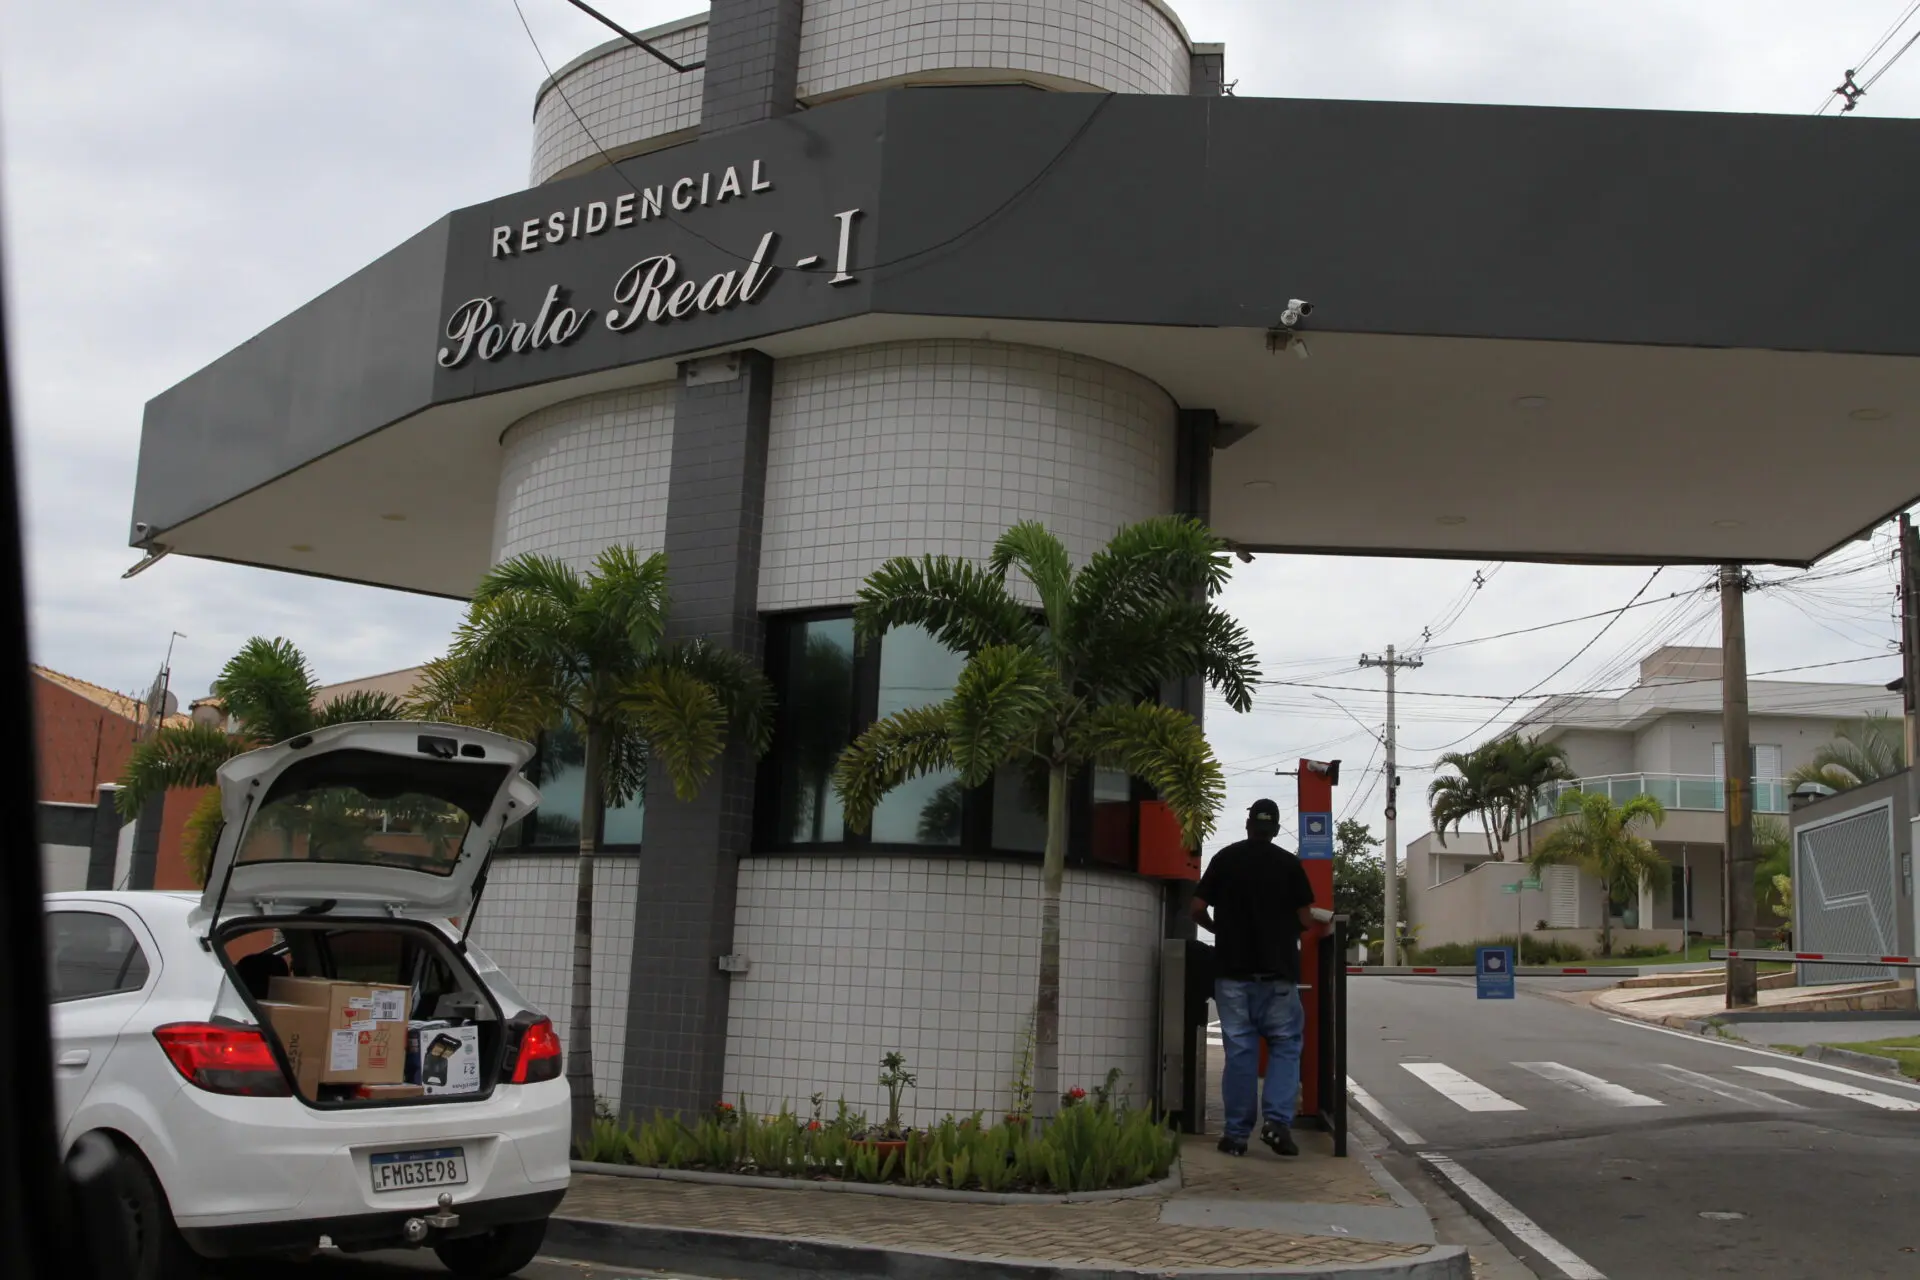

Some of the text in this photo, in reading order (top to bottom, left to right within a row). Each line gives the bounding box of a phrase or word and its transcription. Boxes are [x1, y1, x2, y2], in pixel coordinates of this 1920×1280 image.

[491, 159, 772, 257] RESIDENCIAL
[437, 284, 591, 368] Porto
[605, 231, 775, 331] Real
[381, 1160, 457, 1187] FMG3E98
